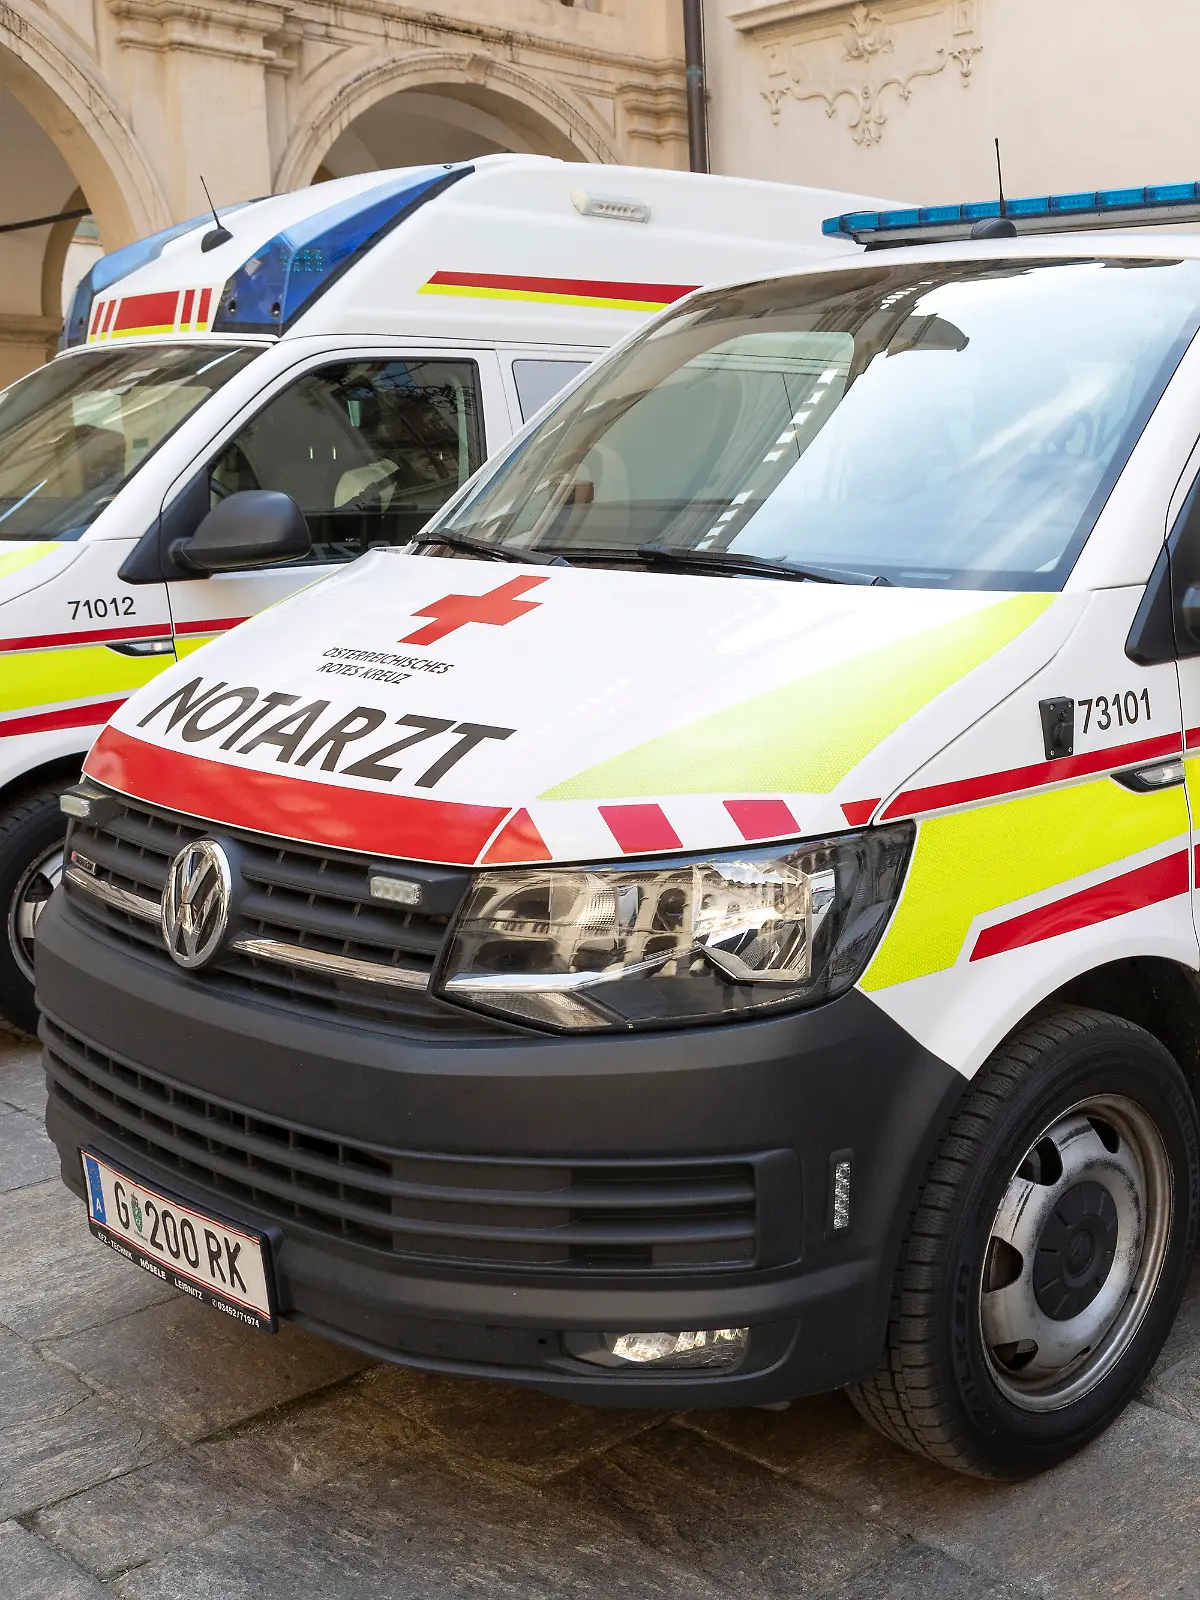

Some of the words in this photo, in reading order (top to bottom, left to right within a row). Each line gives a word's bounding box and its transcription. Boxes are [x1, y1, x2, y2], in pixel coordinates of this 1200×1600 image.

[67, 596, 136, 620] 71012
[316, 662, 365, 676] ROTES
[358, 667, 412, 684] KREUZ
[322, 647, 454, 674] ÖSTERREICHISCHES
[1078, 688, 1151, 734] 73101
[137, 677, 517, 788] NOTARZT
[96, 1197, 103, 1213] A
[114, 1180, 130, 1230] G
[144, 1200, 200, 1269] 200
[204, 1227, 247, 1294] RK
[174, 1278, 203, 1300] LEIBNITZ
